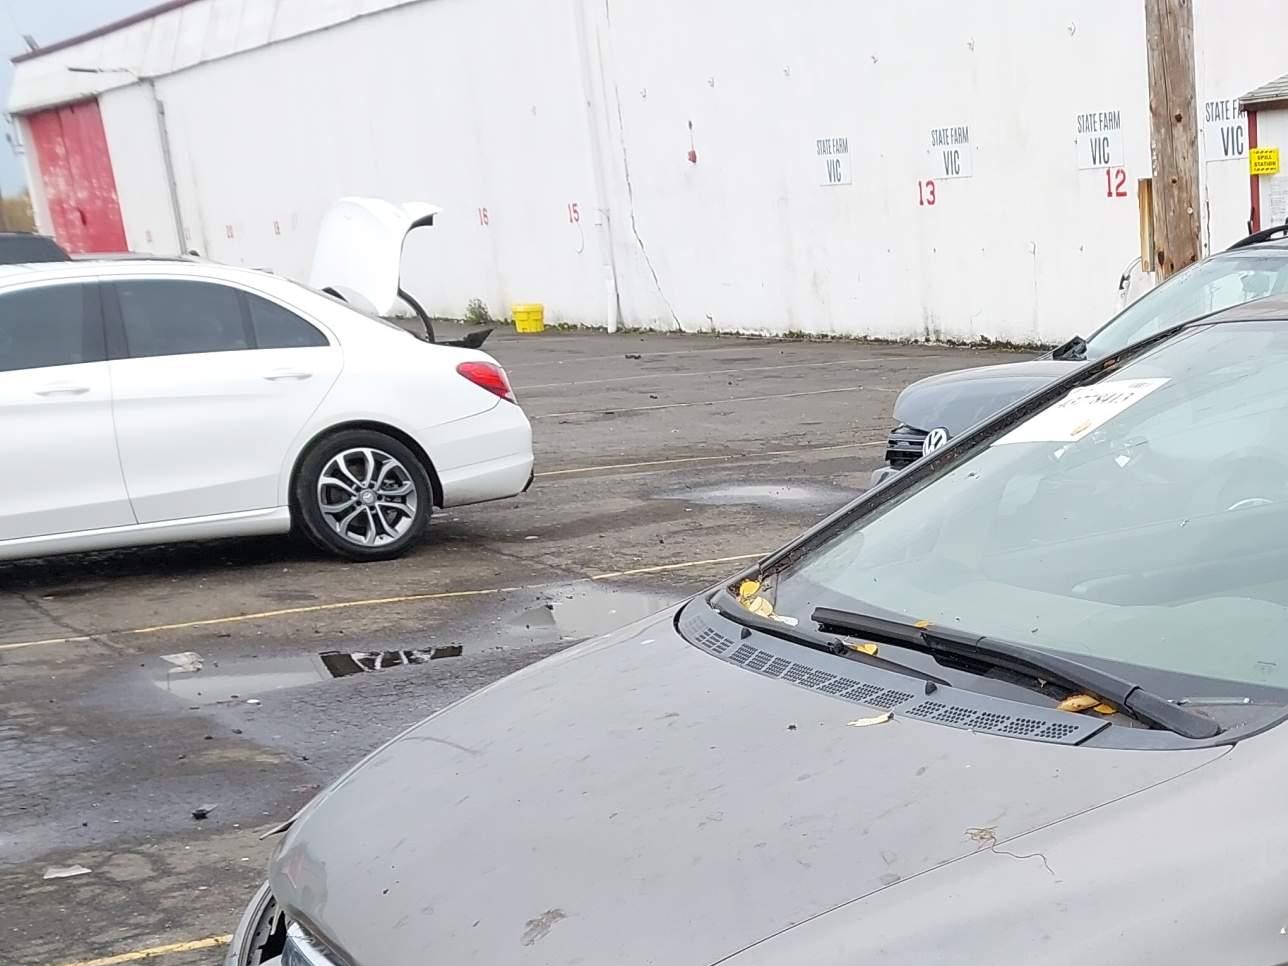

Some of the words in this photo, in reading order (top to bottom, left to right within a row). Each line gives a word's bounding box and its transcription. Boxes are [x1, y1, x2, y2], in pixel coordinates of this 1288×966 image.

[1077, 114, 1098, 133] STATE
[1099, 111, 1121, 131] FARM
[1205, 100, 1230, 122] STATE
[816, 138, 831, 155] STATE
[832, 137, 848, 154] FARM
[931, 129, 949, 147] STATE
[950, 126, 969, 145] FARM
[1220, 125, 1244, 156] VIC
[943, 150, 960, 175] VIC
[1090, 136, 1110, 165] VIC
[827, 159, 842, 183] VIC
[1105, 167, 1127, 197] 12
[918, 180, 936, 206] 13
[568, 202, 580, 223] 15
